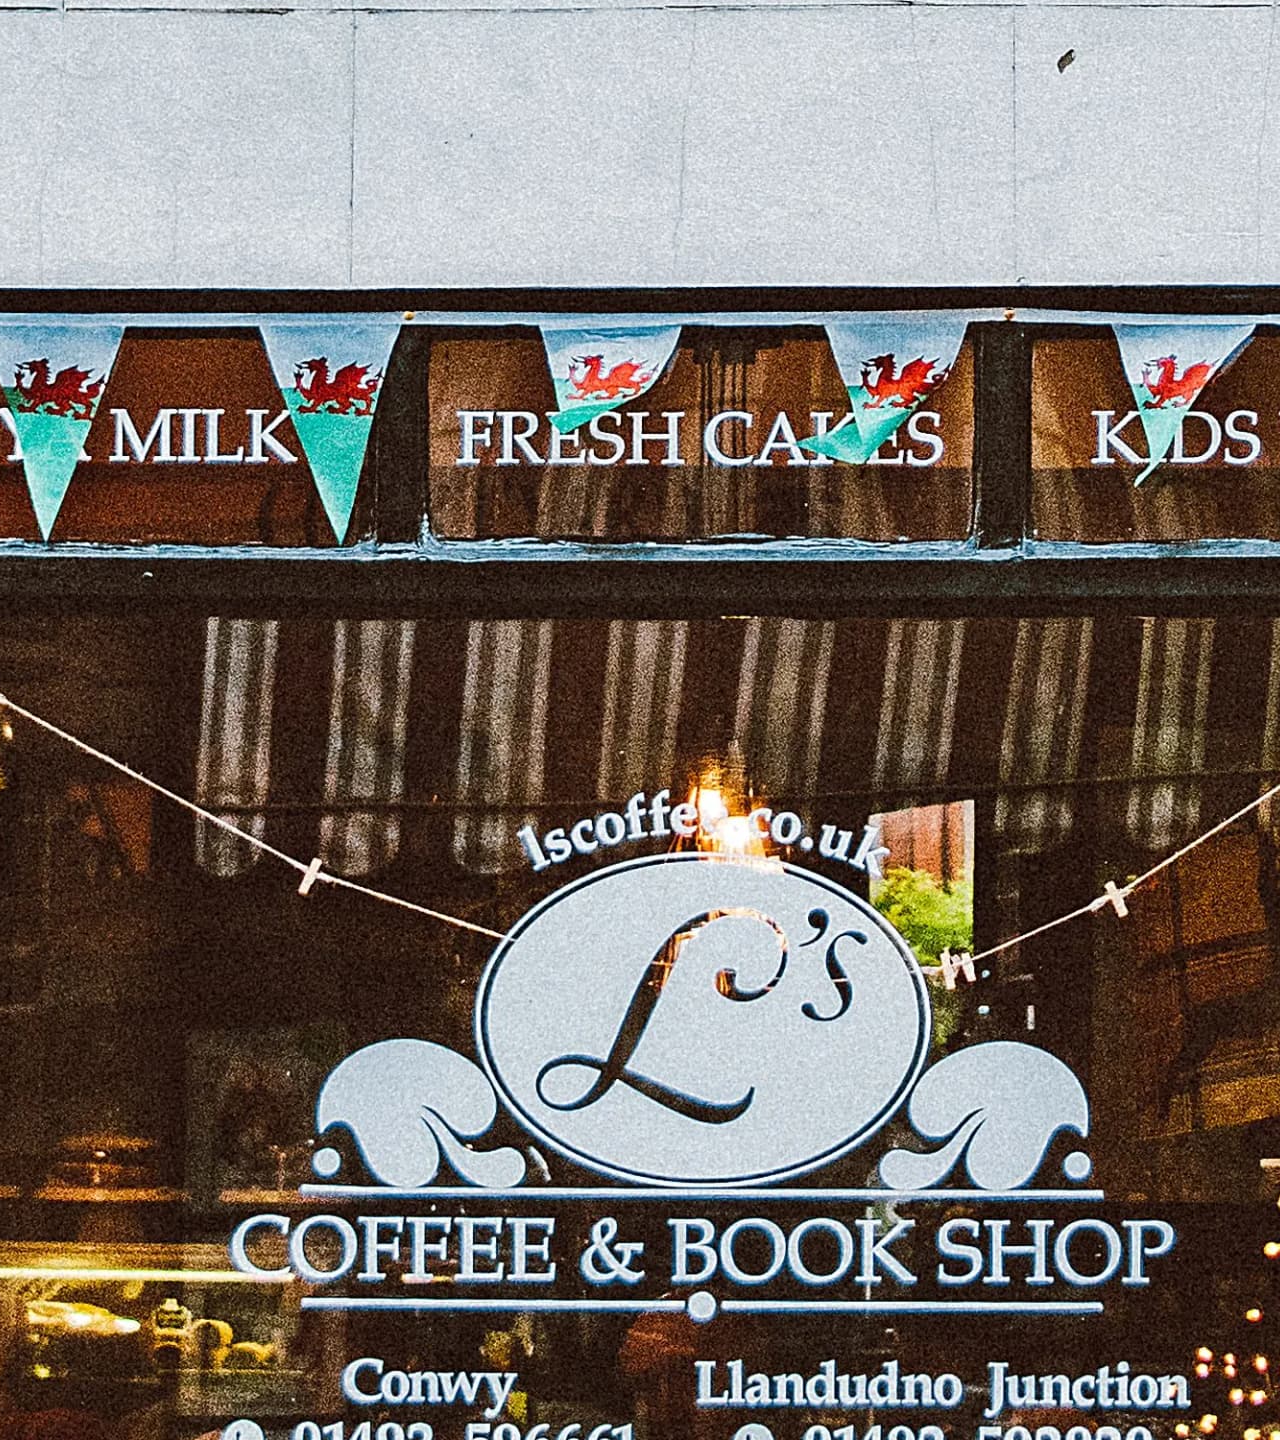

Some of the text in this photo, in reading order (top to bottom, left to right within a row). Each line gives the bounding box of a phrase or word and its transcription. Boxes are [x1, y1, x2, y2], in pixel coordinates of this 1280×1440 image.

[108, 407, 300, 464] MILK
[455, 410, 686, 466] FRESH
[1090, 410, 1261, 465] KDS
[229, 1214, 1176, 1288] COFFEE & BOOK SHOP
[341, 1357, 519, 1419] Conwy
[693, 1360, 1191, 1412] Llandudno Junction
